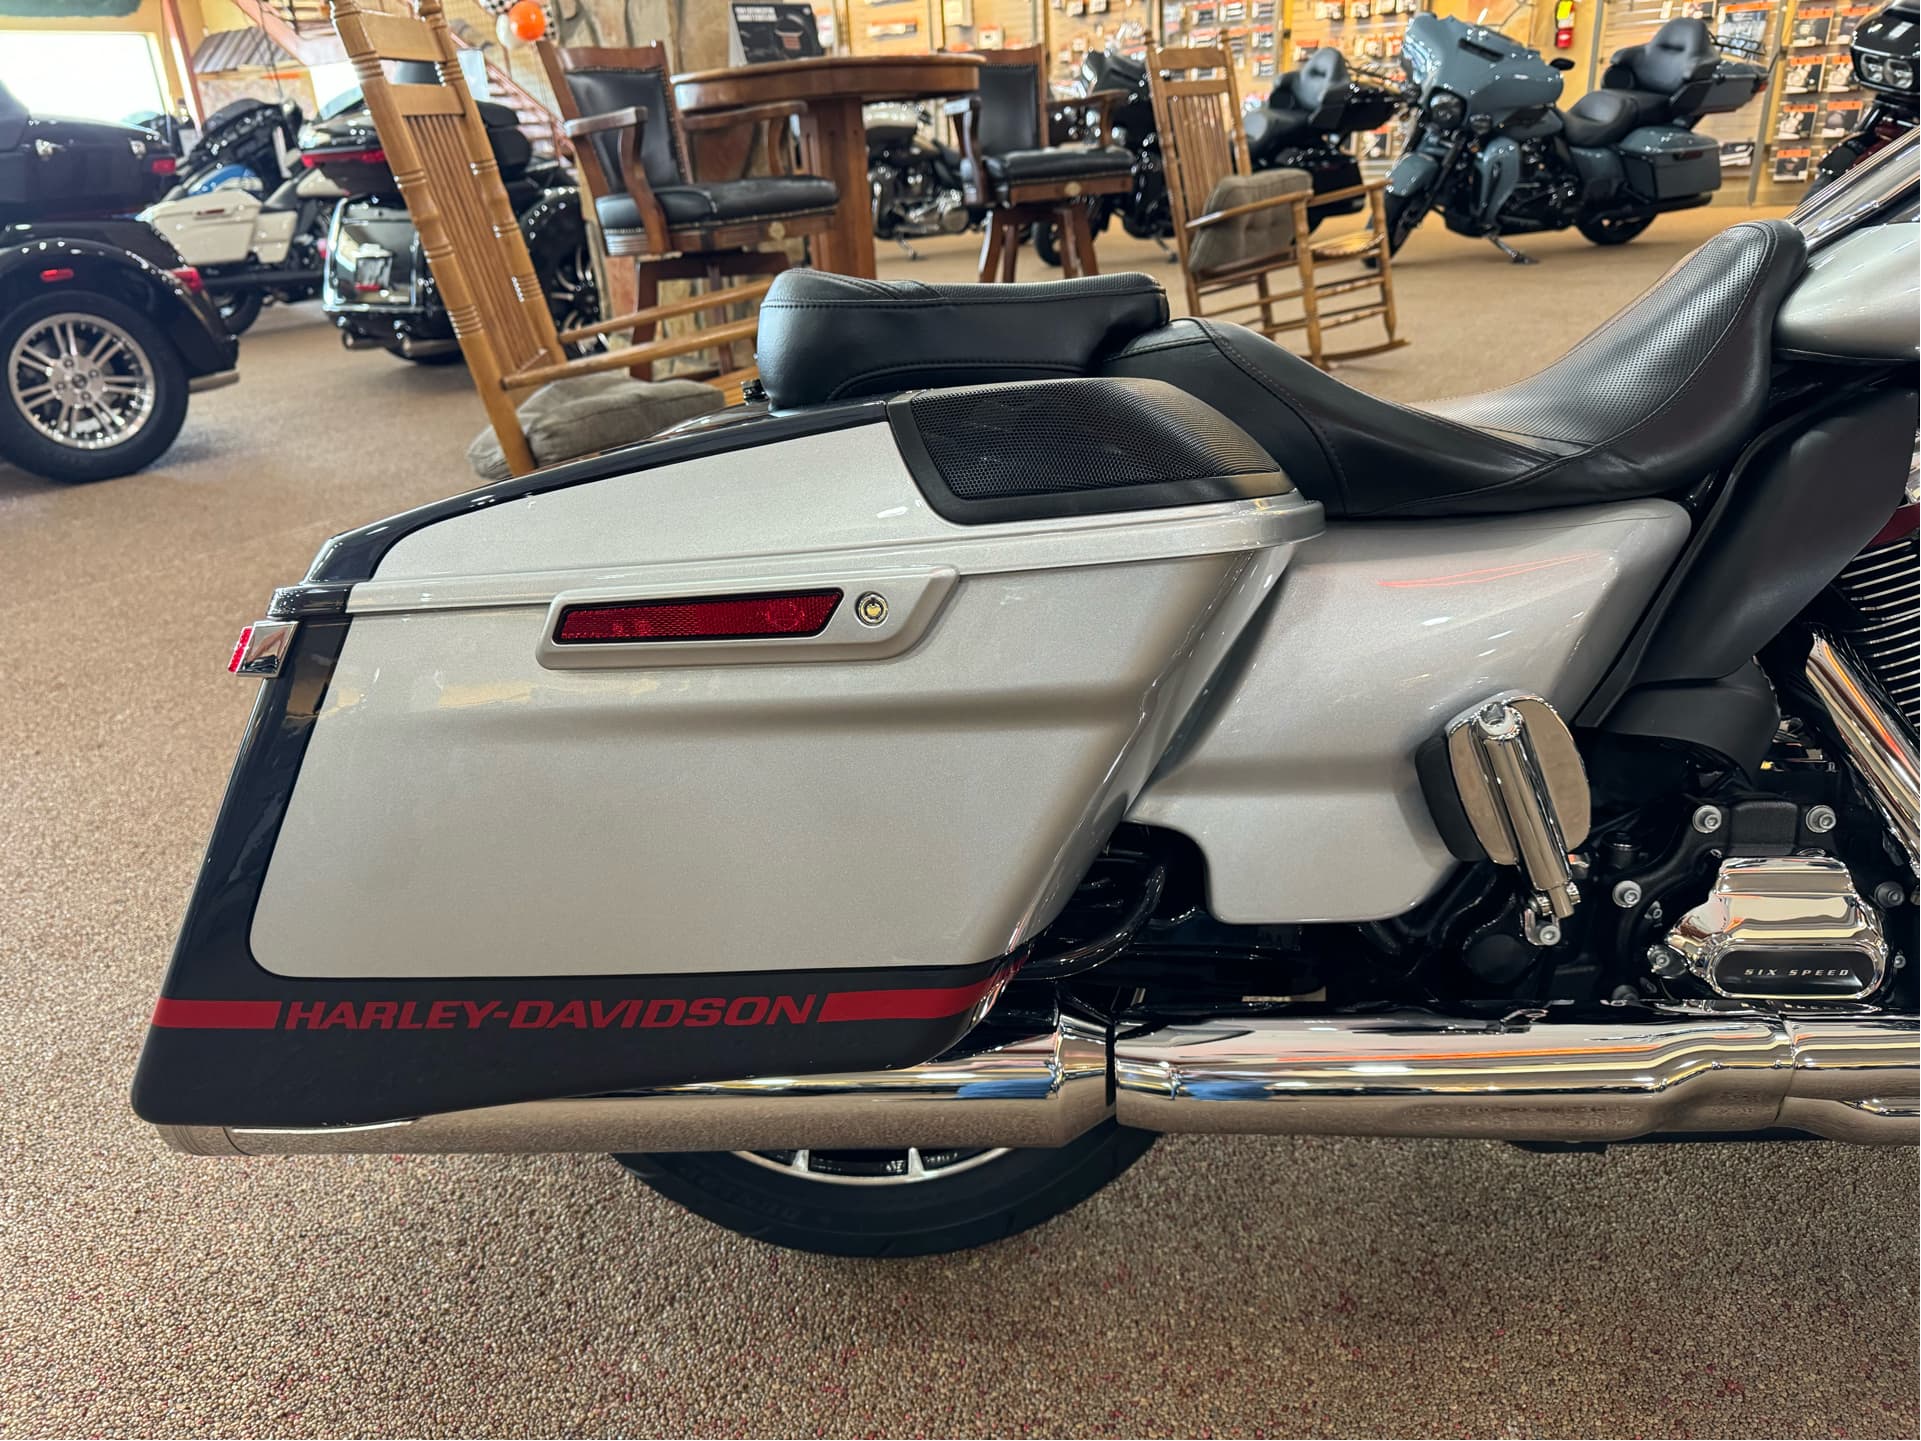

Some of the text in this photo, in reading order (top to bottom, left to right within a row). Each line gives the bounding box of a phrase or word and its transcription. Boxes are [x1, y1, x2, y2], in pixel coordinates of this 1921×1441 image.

[1744, 968, 1849, 977] SIX SPEED
[284, 994, 817, 1030] HARLEY-DAVIDSON
